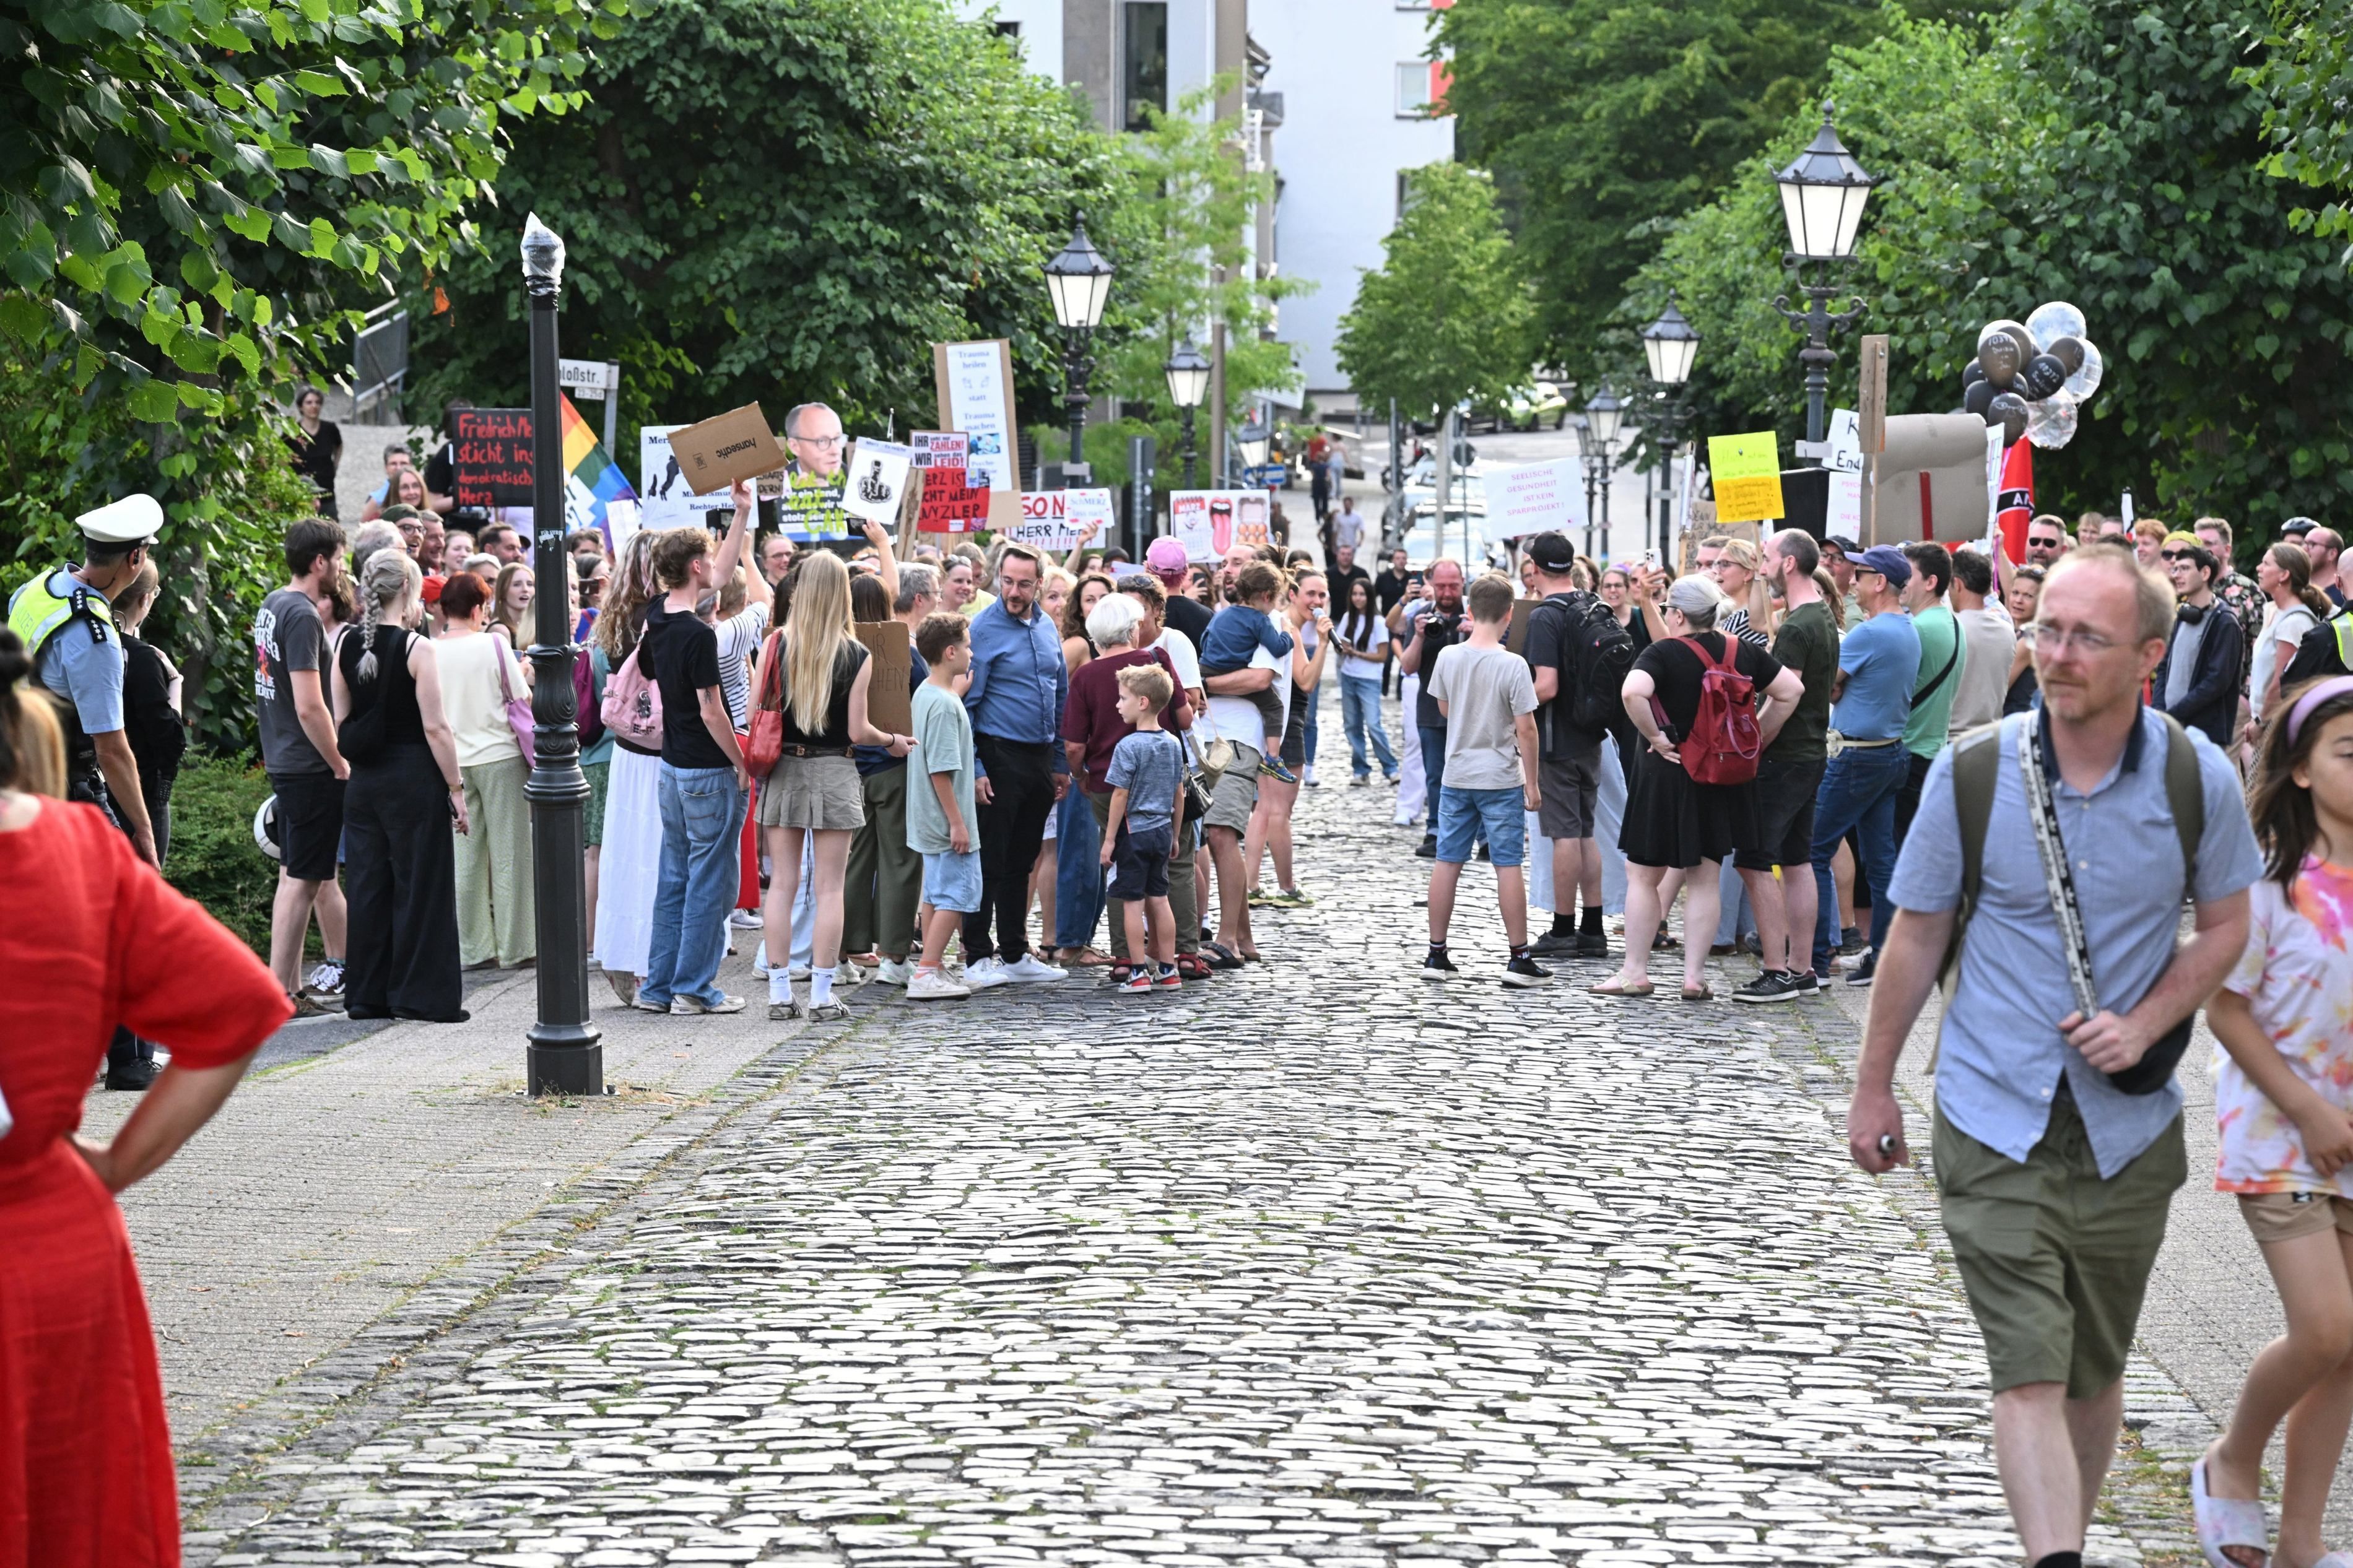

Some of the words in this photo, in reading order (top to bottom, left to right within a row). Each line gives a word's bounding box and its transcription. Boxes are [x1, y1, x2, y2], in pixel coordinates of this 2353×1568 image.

[958, 350, 989, 358] Trauma
[560, 366, 599, 384] loßstr.
[963, 412, 996, 421] Trauma
[459, 413, 516, 439] Friedrich
[518, 416, 533, 438] Me
[965, 423, 996, 431] machen
[1848, 417, 1859, 435] K
[648, 436, 670, 444] Mer
[915, 436, 928, 447] IHR
[930, 440, 964, 451] ZAHLEN!
[457, 441, 505, 464] sticht
[716, 438, 757, 459] hanseatic
[915, 453, 932, 466] WIR
[934, 457, 964, 467] LEID!
[1837, 451, 1860, 470] End
[458, 467, 533, 485] demokratisch
[926, 472, 947, 486] ERZ
[952, 472, 966, 487] IST
[1511, 469, 1554, 480] SEELISCHE
[1507, 480, 1557, 493] GESUNDHEIT
[458, 485, 493, 505] Herz
[921, 490, 945, 503] CHT
[948, 488, 979, 502] MEIN
[1523, 495, 1536, 503] IST
[1536, 492, 1555, 501] KEIN
[690, 502, 719, 511] Rechter
[721, 501, 736, 509] Het
[919, 503, 980, 521] ANZLER
[1053, 495, 1064, 516] N
[782, 513, 806, 522] stolz
[1017, 524, 1051, 538] HERR
[1059, 523, 1082, 536] ME
